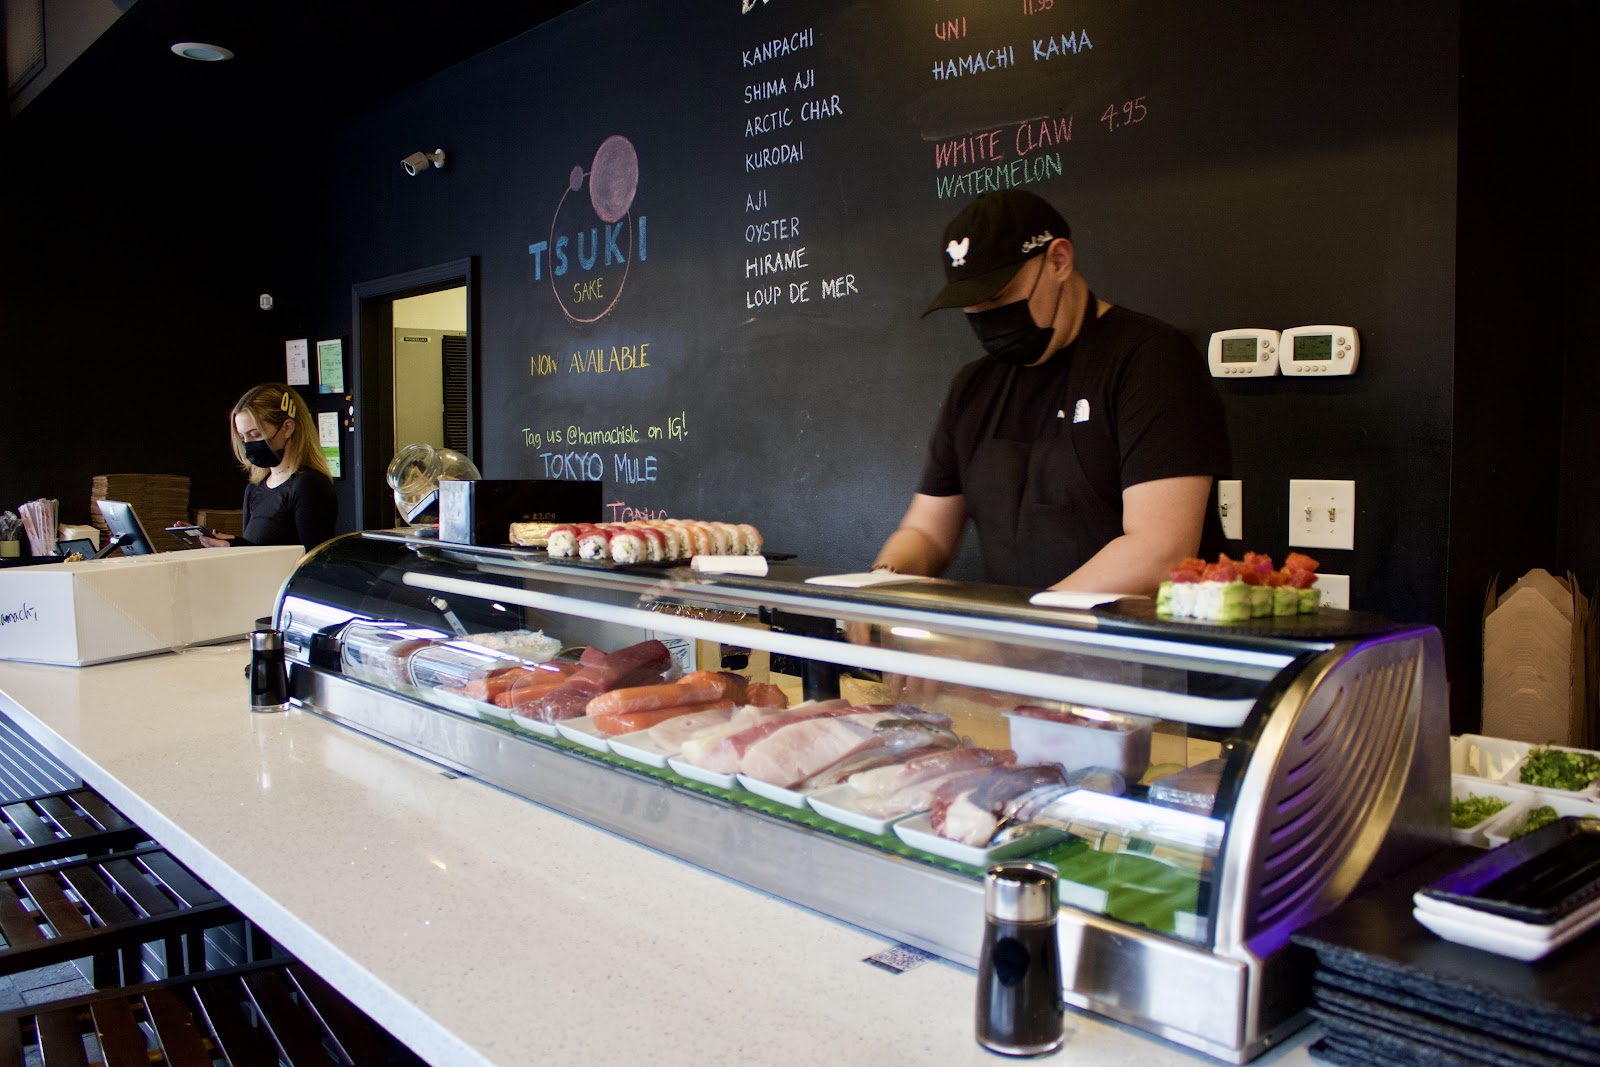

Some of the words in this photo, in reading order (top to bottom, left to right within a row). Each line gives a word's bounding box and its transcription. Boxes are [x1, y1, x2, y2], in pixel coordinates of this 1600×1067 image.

[935, 16, 967, 41] UNI
[742, 27, 814, 68] KANPACHI
[932, 46, 1014, 80] HAMACHI
[1032, 29, 1093, 61] KAMA
[744, 77, 787, 104] SHIMA
[793, 69, 815, 92] AJI
[745, 107, 793, 138] ARCTIC
[801, 94, 843, 121] CHAR
[935, 130, 1004, 170] WHITE
[1016, 114, 1073, 157] CLAW
[1101, 96, 1148, 133] 4.95
[746, 141, 804, 173] KURODAI
[936, 153, 1063, 200] WATERMELON
[746, 189, 767, 213] AJI
[528, 215, 648, 281] TSUKI
[745, 217, 800, 244] OYSTER
[746, 247, 809, 278] HIRAME
[573, 277, 604, 304] SAKE
[746, 285, 781, 310] LOUP
[789, 281, 810, 305] DE
[822, 274, 858, 300] MER
[530, 352, 560, 377] NOW
[568, 343, 651, 374] AVAILABLE
[522, 428, 541, 450] Tag
[546, 429, 562, 444] us
[566, 424, 640, 446] @hamachislc
[647, 426, 663, 440] on
[667, 410, 689, 442] IG!
[540, 451, 604, 482] TOKYO
[614, 452, 658, 484] MULE
